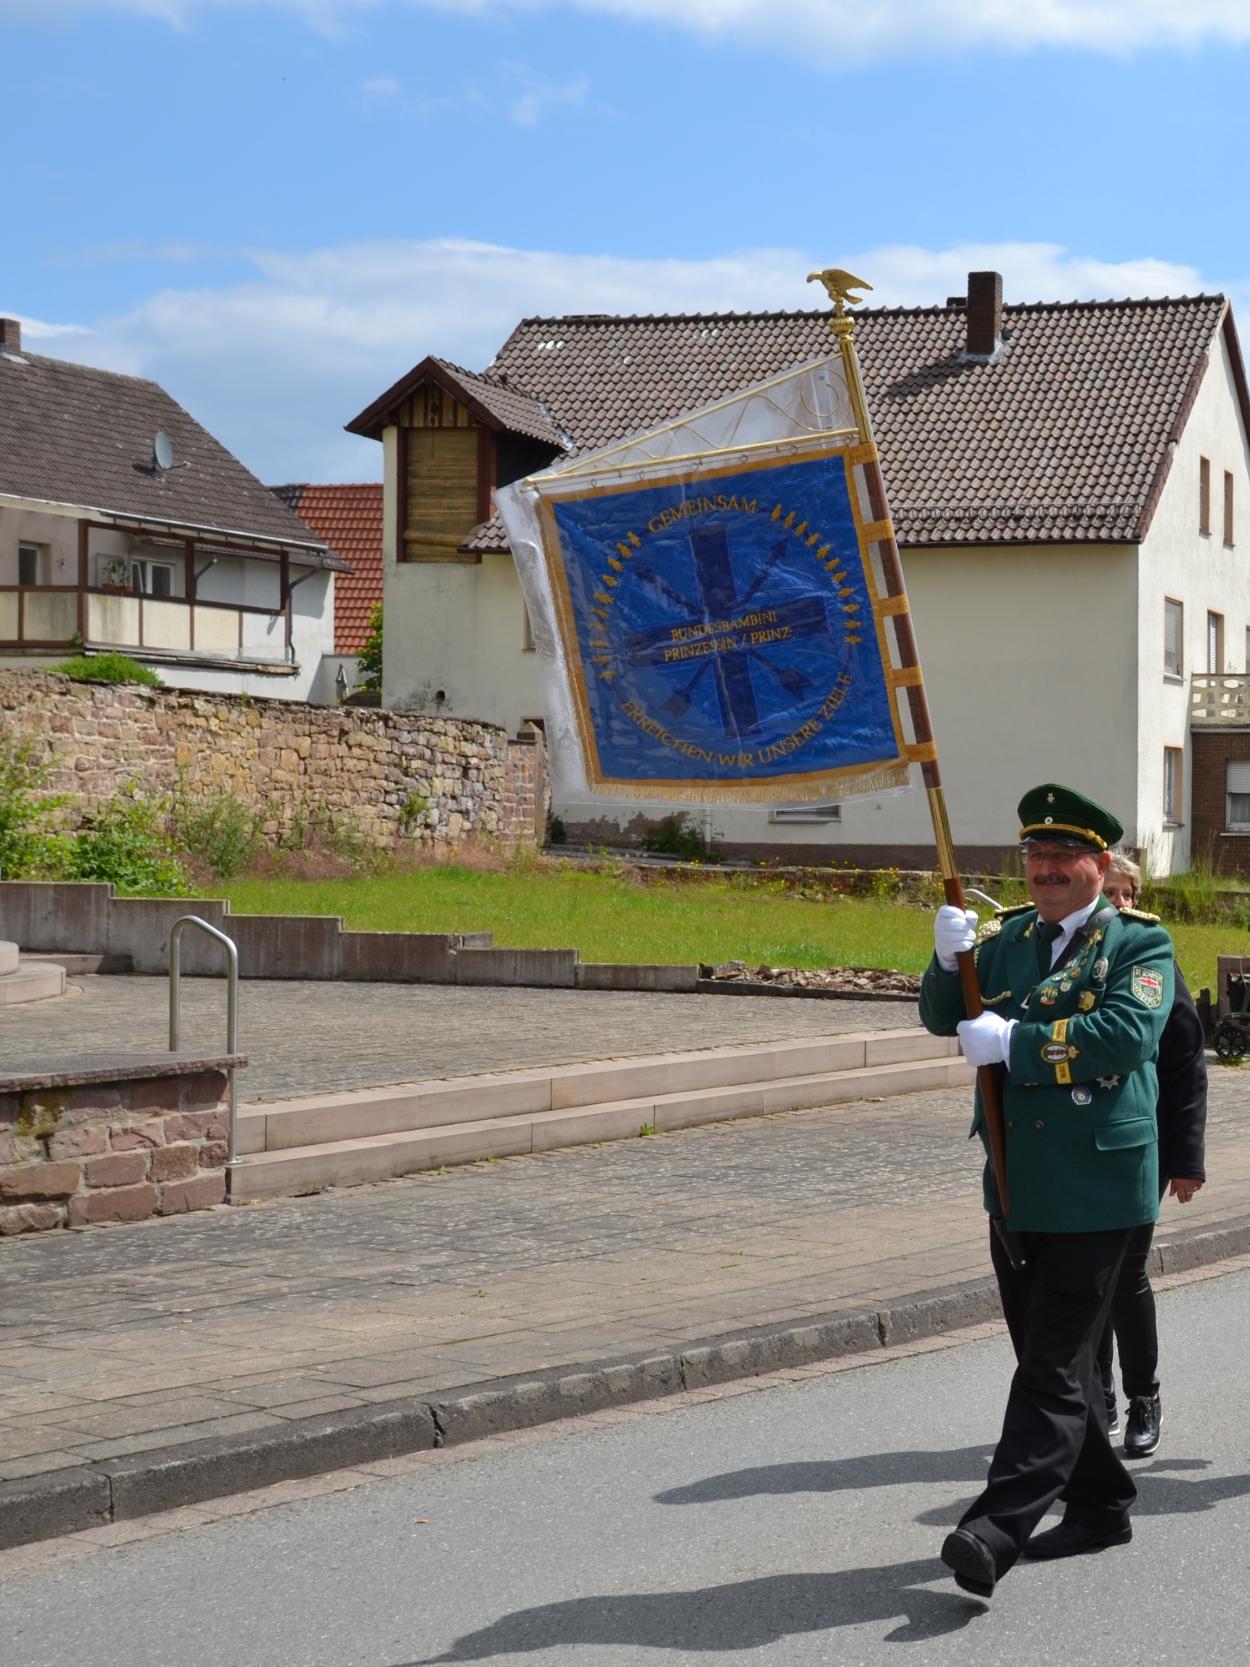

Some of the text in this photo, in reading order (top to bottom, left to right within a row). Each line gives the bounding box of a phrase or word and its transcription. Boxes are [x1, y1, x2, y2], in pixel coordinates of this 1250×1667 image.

[647, 495, 757, 533] GEMEINSAM
[671, 610, 778, 642] BUNDESBAMBINI
[620, 672, 853, 768] ERREICHEN WIR UNSERE ZIELE
